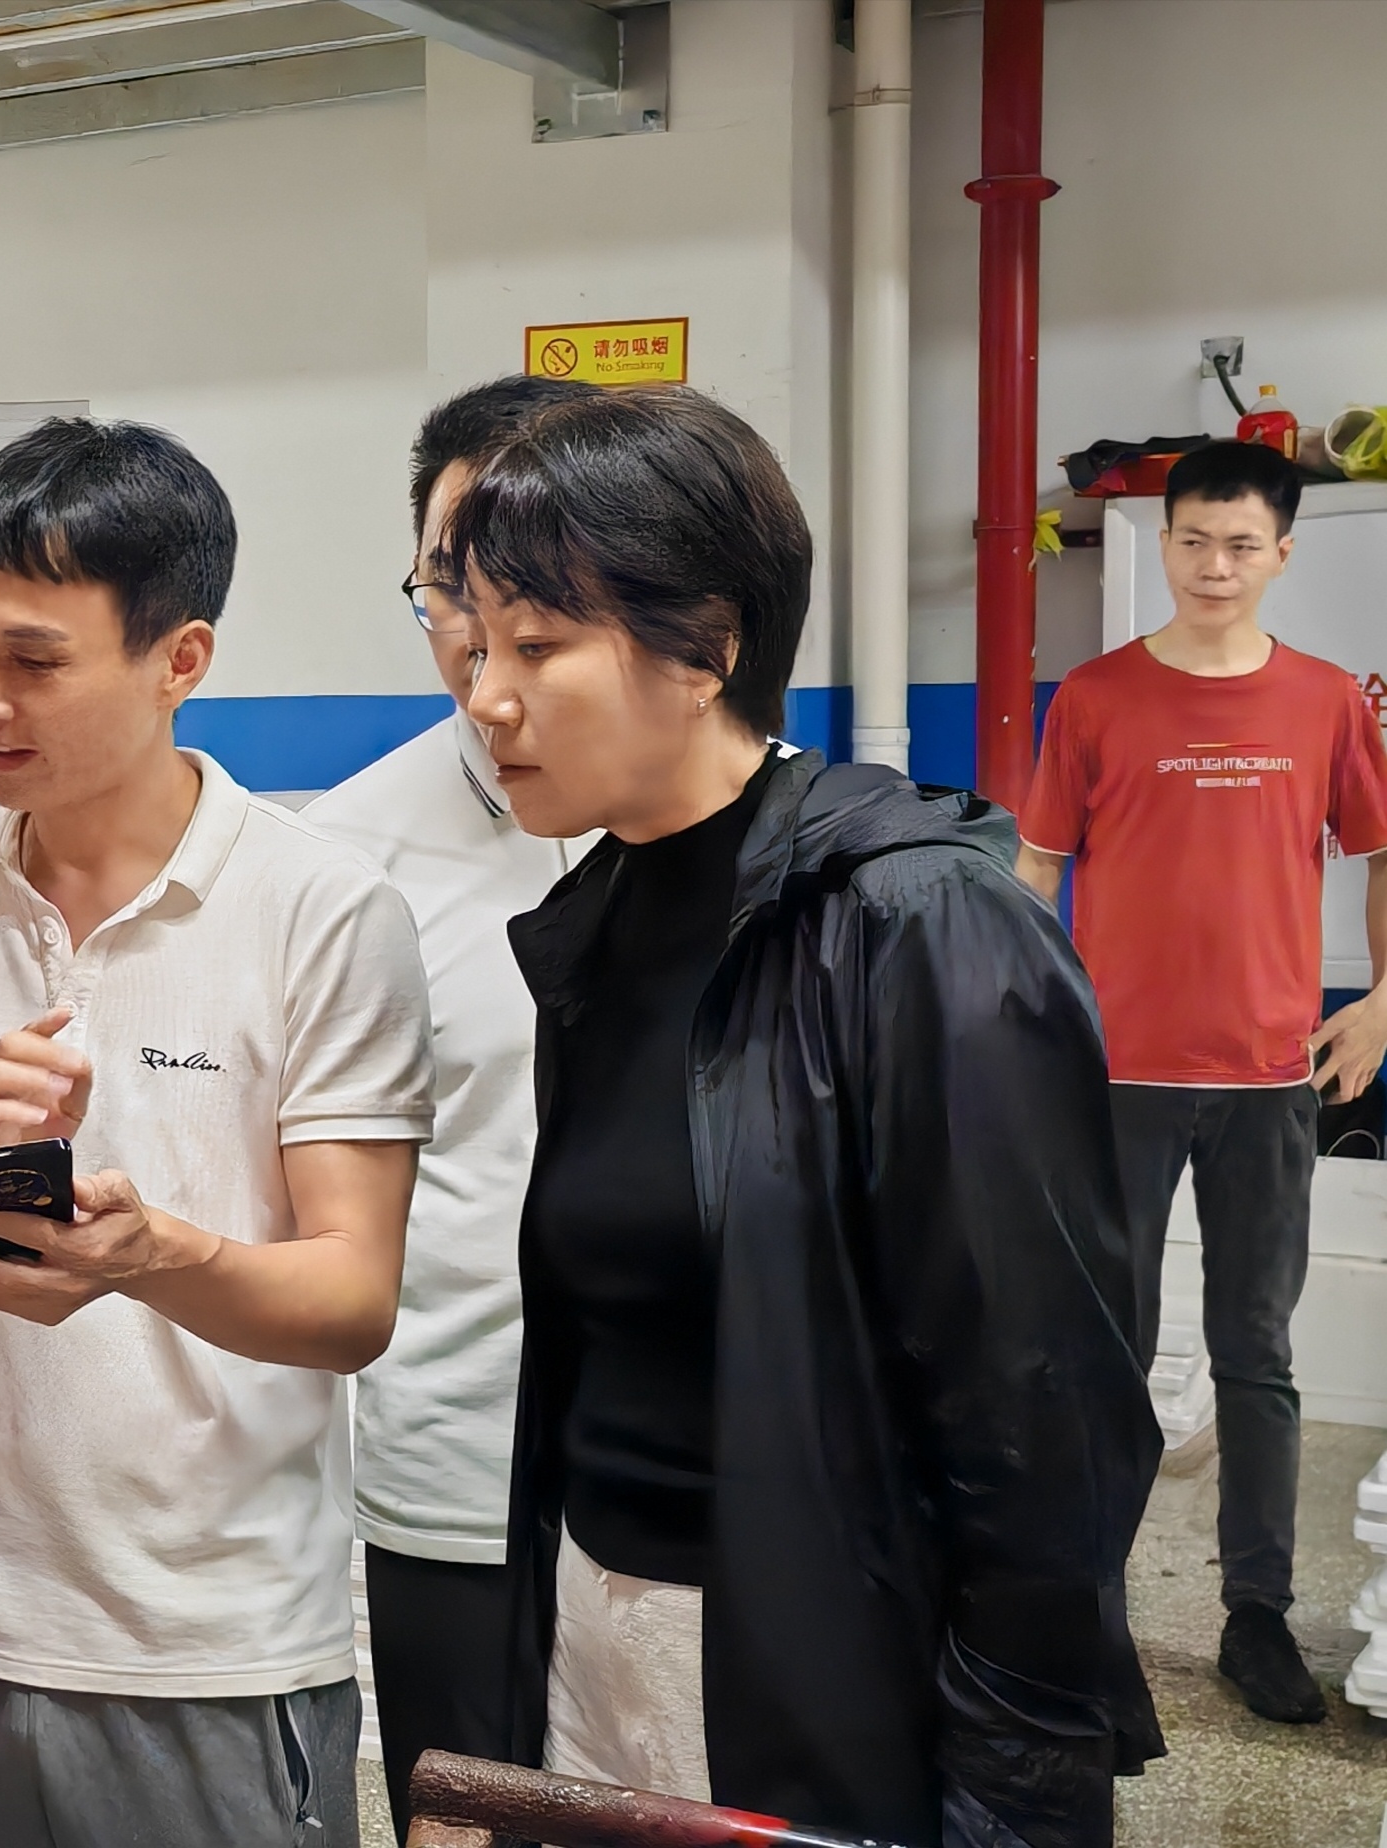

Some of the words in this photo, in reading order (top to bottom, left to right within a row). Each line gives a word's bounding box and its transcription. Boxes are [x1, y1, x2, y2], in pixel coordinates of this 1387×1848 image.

[594, 336, 668, 358] 请勿吸烟
[596, 362, 613, 373] No
[615, 360, 665, 373] Smoking
